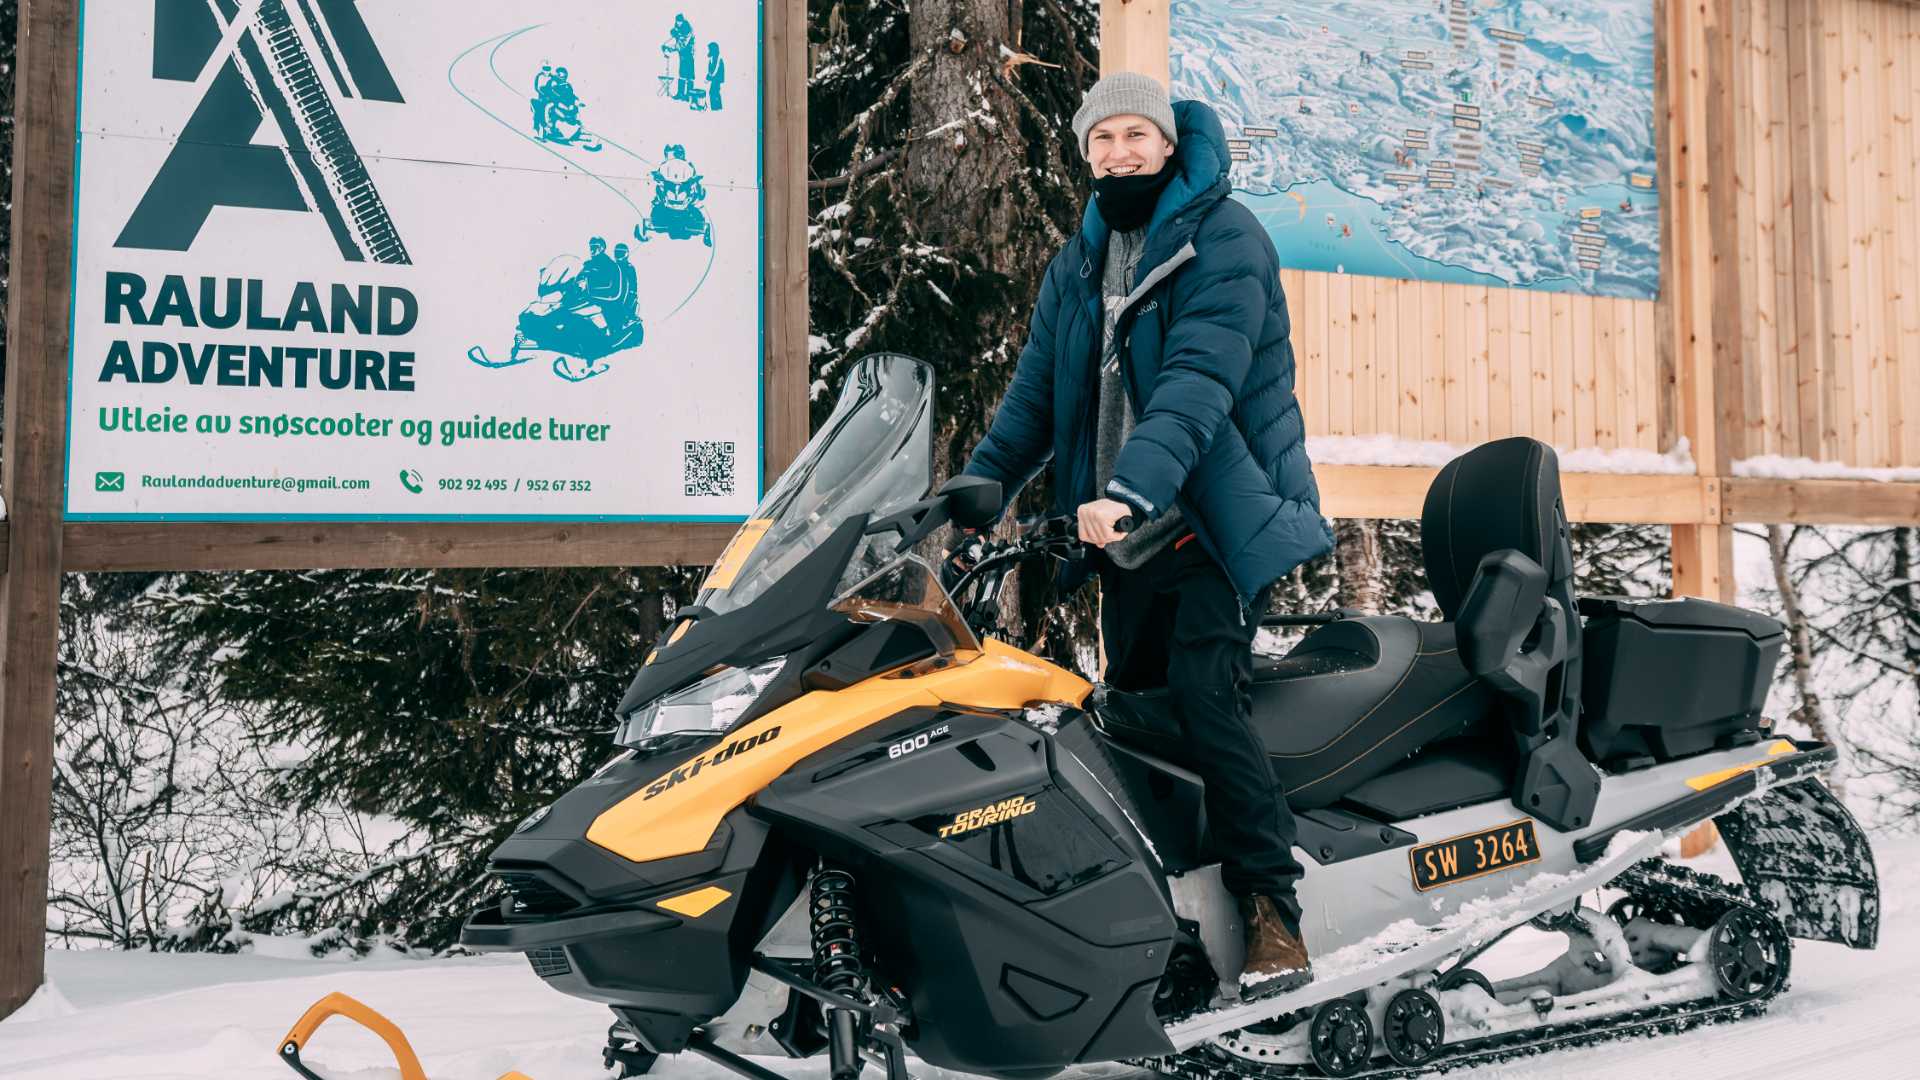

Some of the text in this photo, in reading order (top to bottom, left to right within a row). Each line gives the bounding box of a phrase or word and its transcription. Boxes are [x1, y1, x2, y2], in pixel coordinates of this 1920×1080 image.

[104, 271, 419, 336] RAULAND
[98, 340, 416, 392] ADVENTURE
[99, 406, 611, 447] Utleie av snøscooter og guidede turer
[141, 474, 370, 494] Raulandadventure@gmail.com
[438, 478, 592, 493] 902 92 495 / 952 67 352
[888, 725, 950, 759] 600 ACE
[938, 801, 1037, 838] TOURING
[954, 796, 1026, 824] GRAND
[1425, 828, 1528, 881] SW 3264
